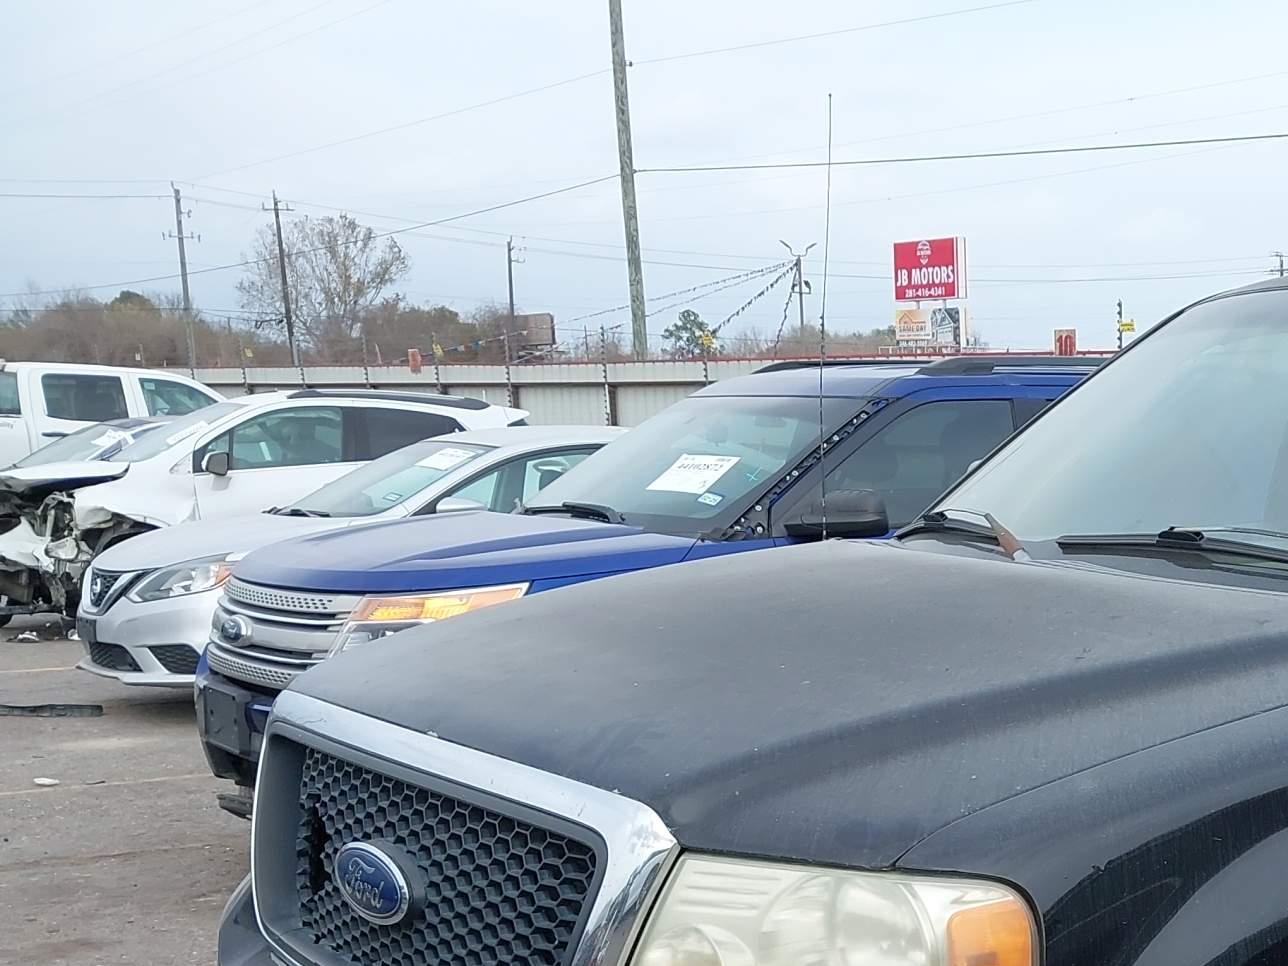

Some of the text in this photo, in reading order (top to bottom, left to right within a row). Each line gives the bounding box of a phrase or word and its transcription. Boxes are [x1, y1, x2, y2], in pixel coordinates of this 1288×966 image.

[896, 265, 954, 287] JB MOTORS
[344, 857, 385, 909] Ford
